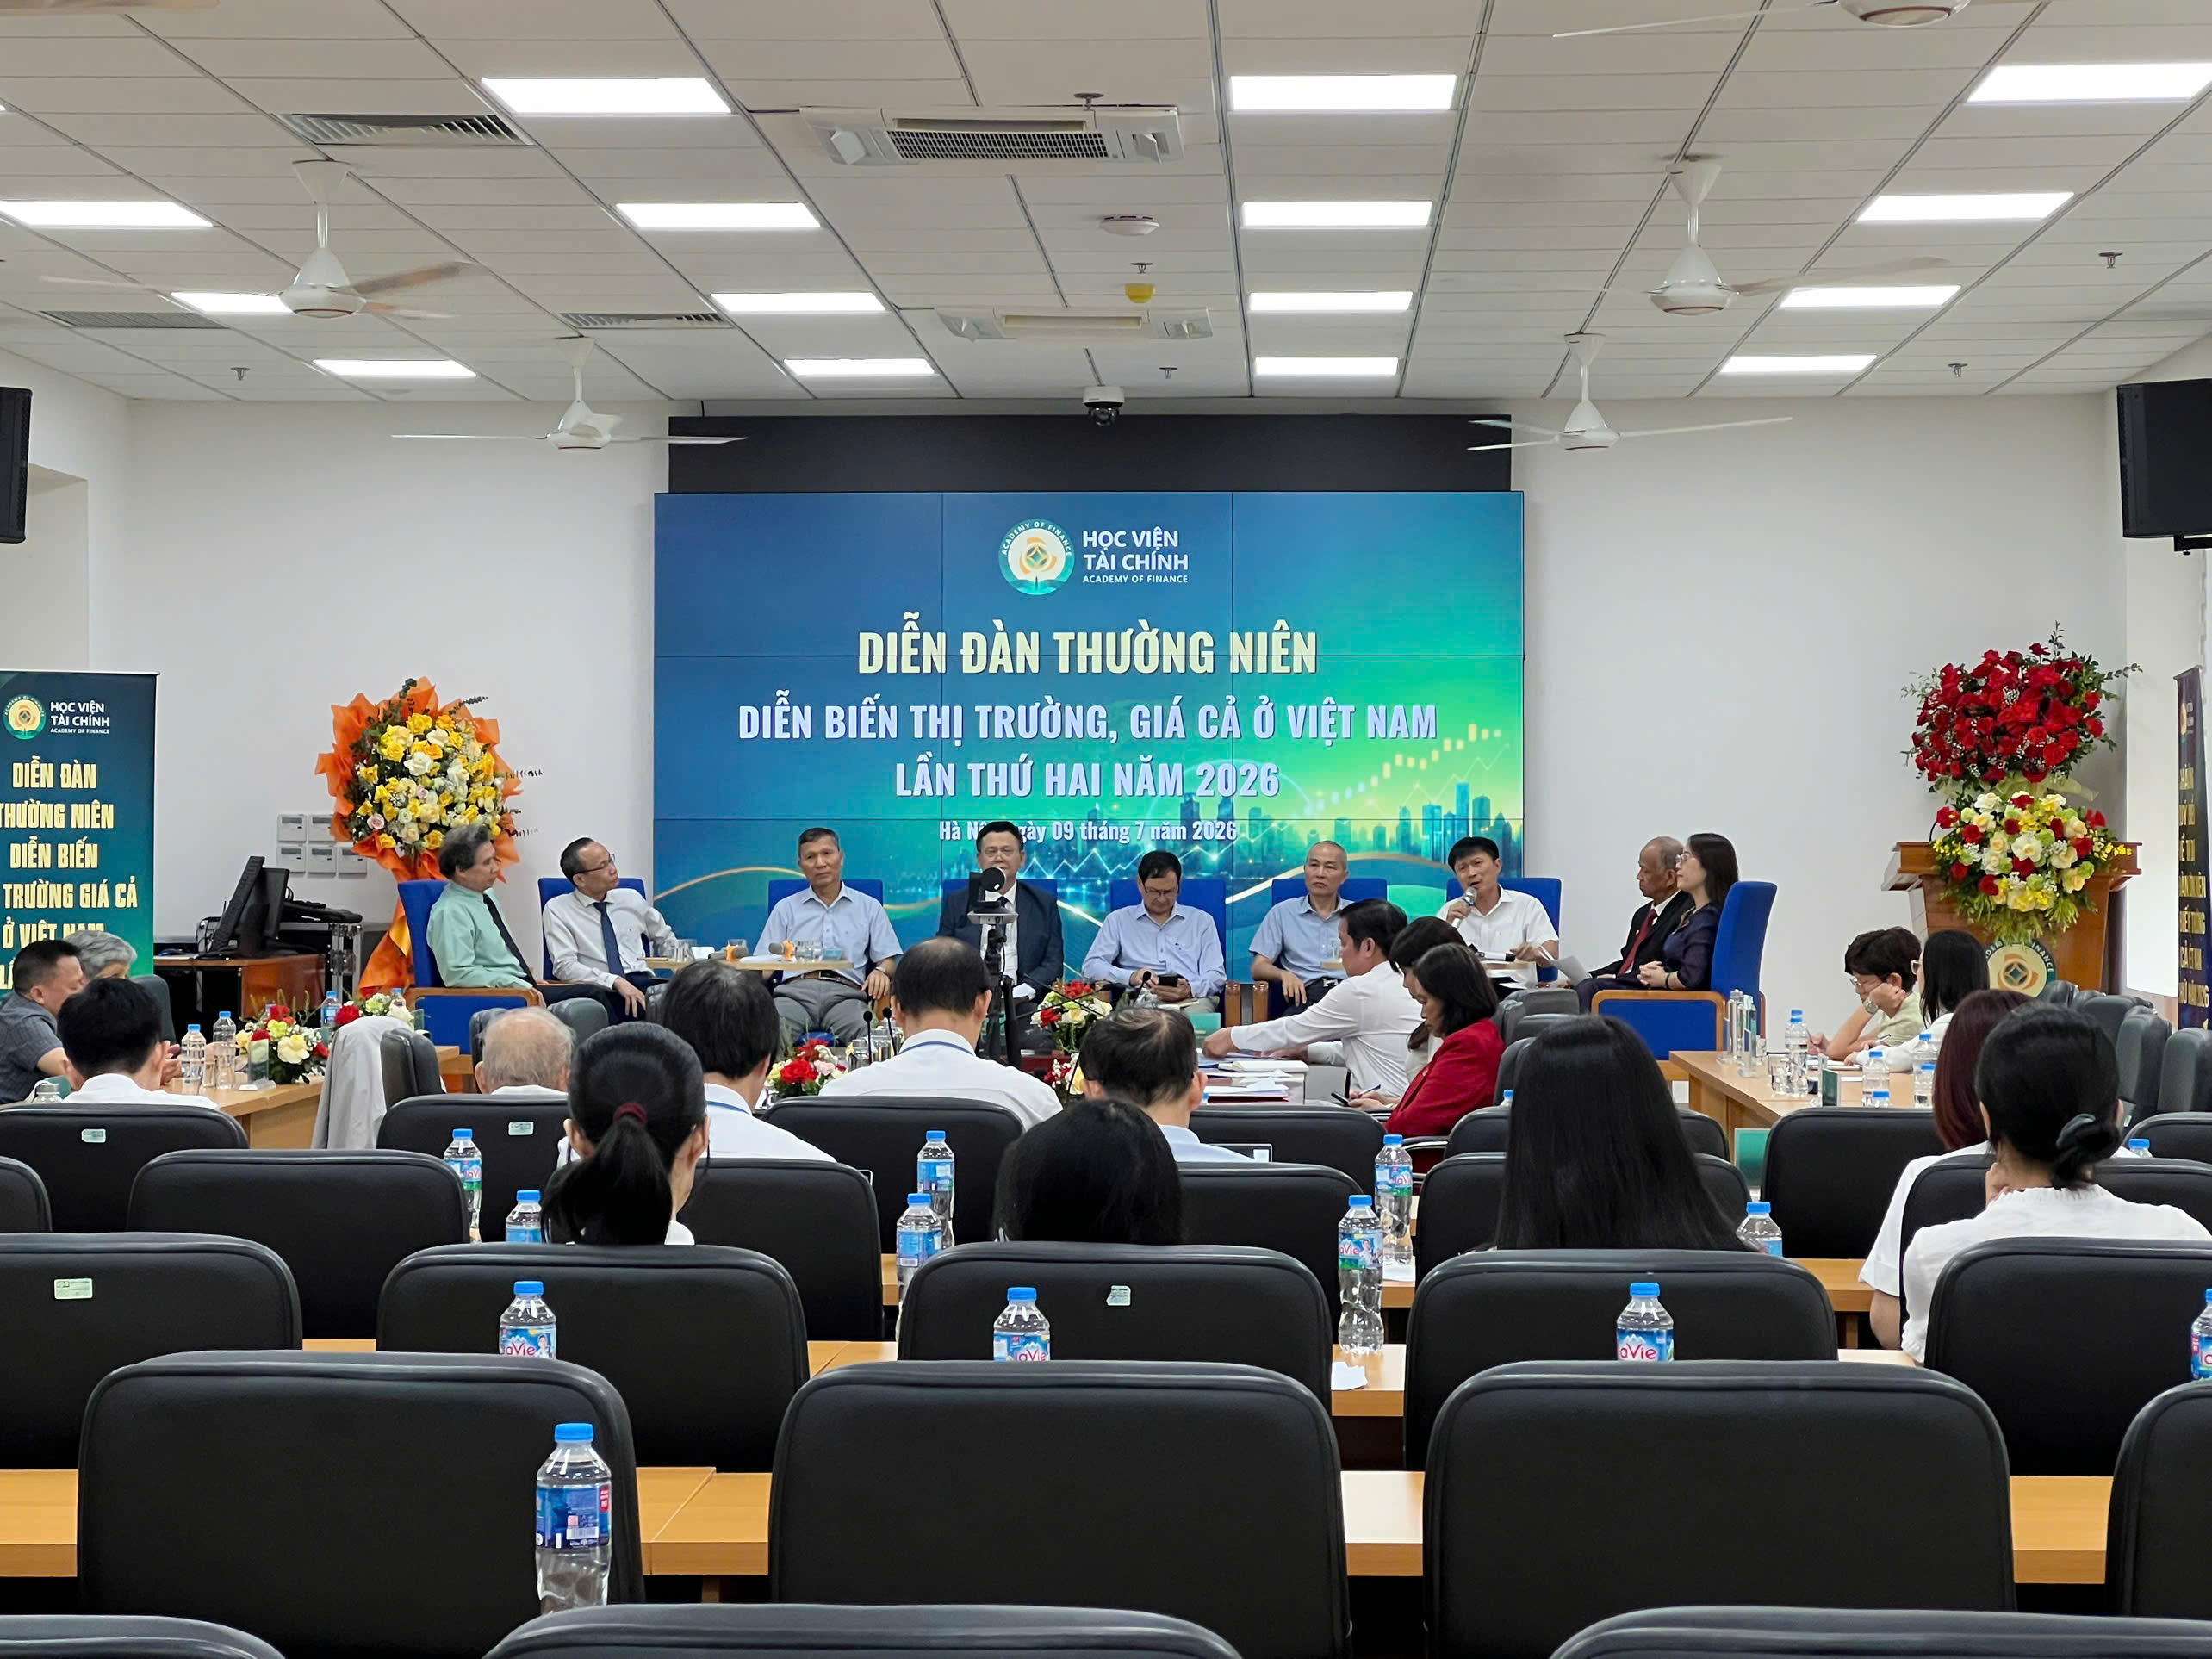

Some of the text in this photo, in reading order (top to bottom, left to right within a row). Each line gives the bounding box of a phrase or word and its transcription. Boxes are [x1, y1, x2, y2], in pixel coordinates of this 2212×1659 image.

[1002, 523, 1030, 555] ACADEMY
[1048, 524, 1072, 556] FINANCE
[1083, 525, 1178, 550] HỌC VIỆN
[1084, 550, 1189, 571] TÀI CHÍNH
[1083, 575, 1188, 583] ACADEMY OF FINANCE
[859, 611, 1317, 674] DIỄN ĐÀN THƯỜNG NIÊN
[50, 701, 76, 714] HỌC
[78, 699, 104, 714] VIỆN
[51, 714, 110, 726] TÀI CHÍNH
[739, 689, 1438, 747] DIỄN BIẾN THỊ TRƯỜNG, GIÁ CẢ Ở VIỆT NAM
[12, 755, 96, 789] DIỄN ĐÀN
[896, 751, 1280, 798] LẦN THỨ HAI NĂM 2026
[71, 799, 114, 829] NIÊN
[940, 820, 961, 841] Hà
[1018, 820, 1047, 844] gày
[1052, 821, 1074, 841] 09
[1079, 820, 1130, 843] tháng
[1135, 821, 1145, 841] 7
[1150, 820, 1187, 841] năm
[1192, 821, 1237, 842] 2026
[9, 836, 98, 869] DIỄN BIẾN
[3, 875, 138, 909] TRƯỜNG GIÁ CẢ
[2, 916, 16, 949] Ở
[2031, 941, 2054, 972] INANCE
[506, 1342, 536, 1356] aVie
[1619, 1343, 1656, 1360] aVie
